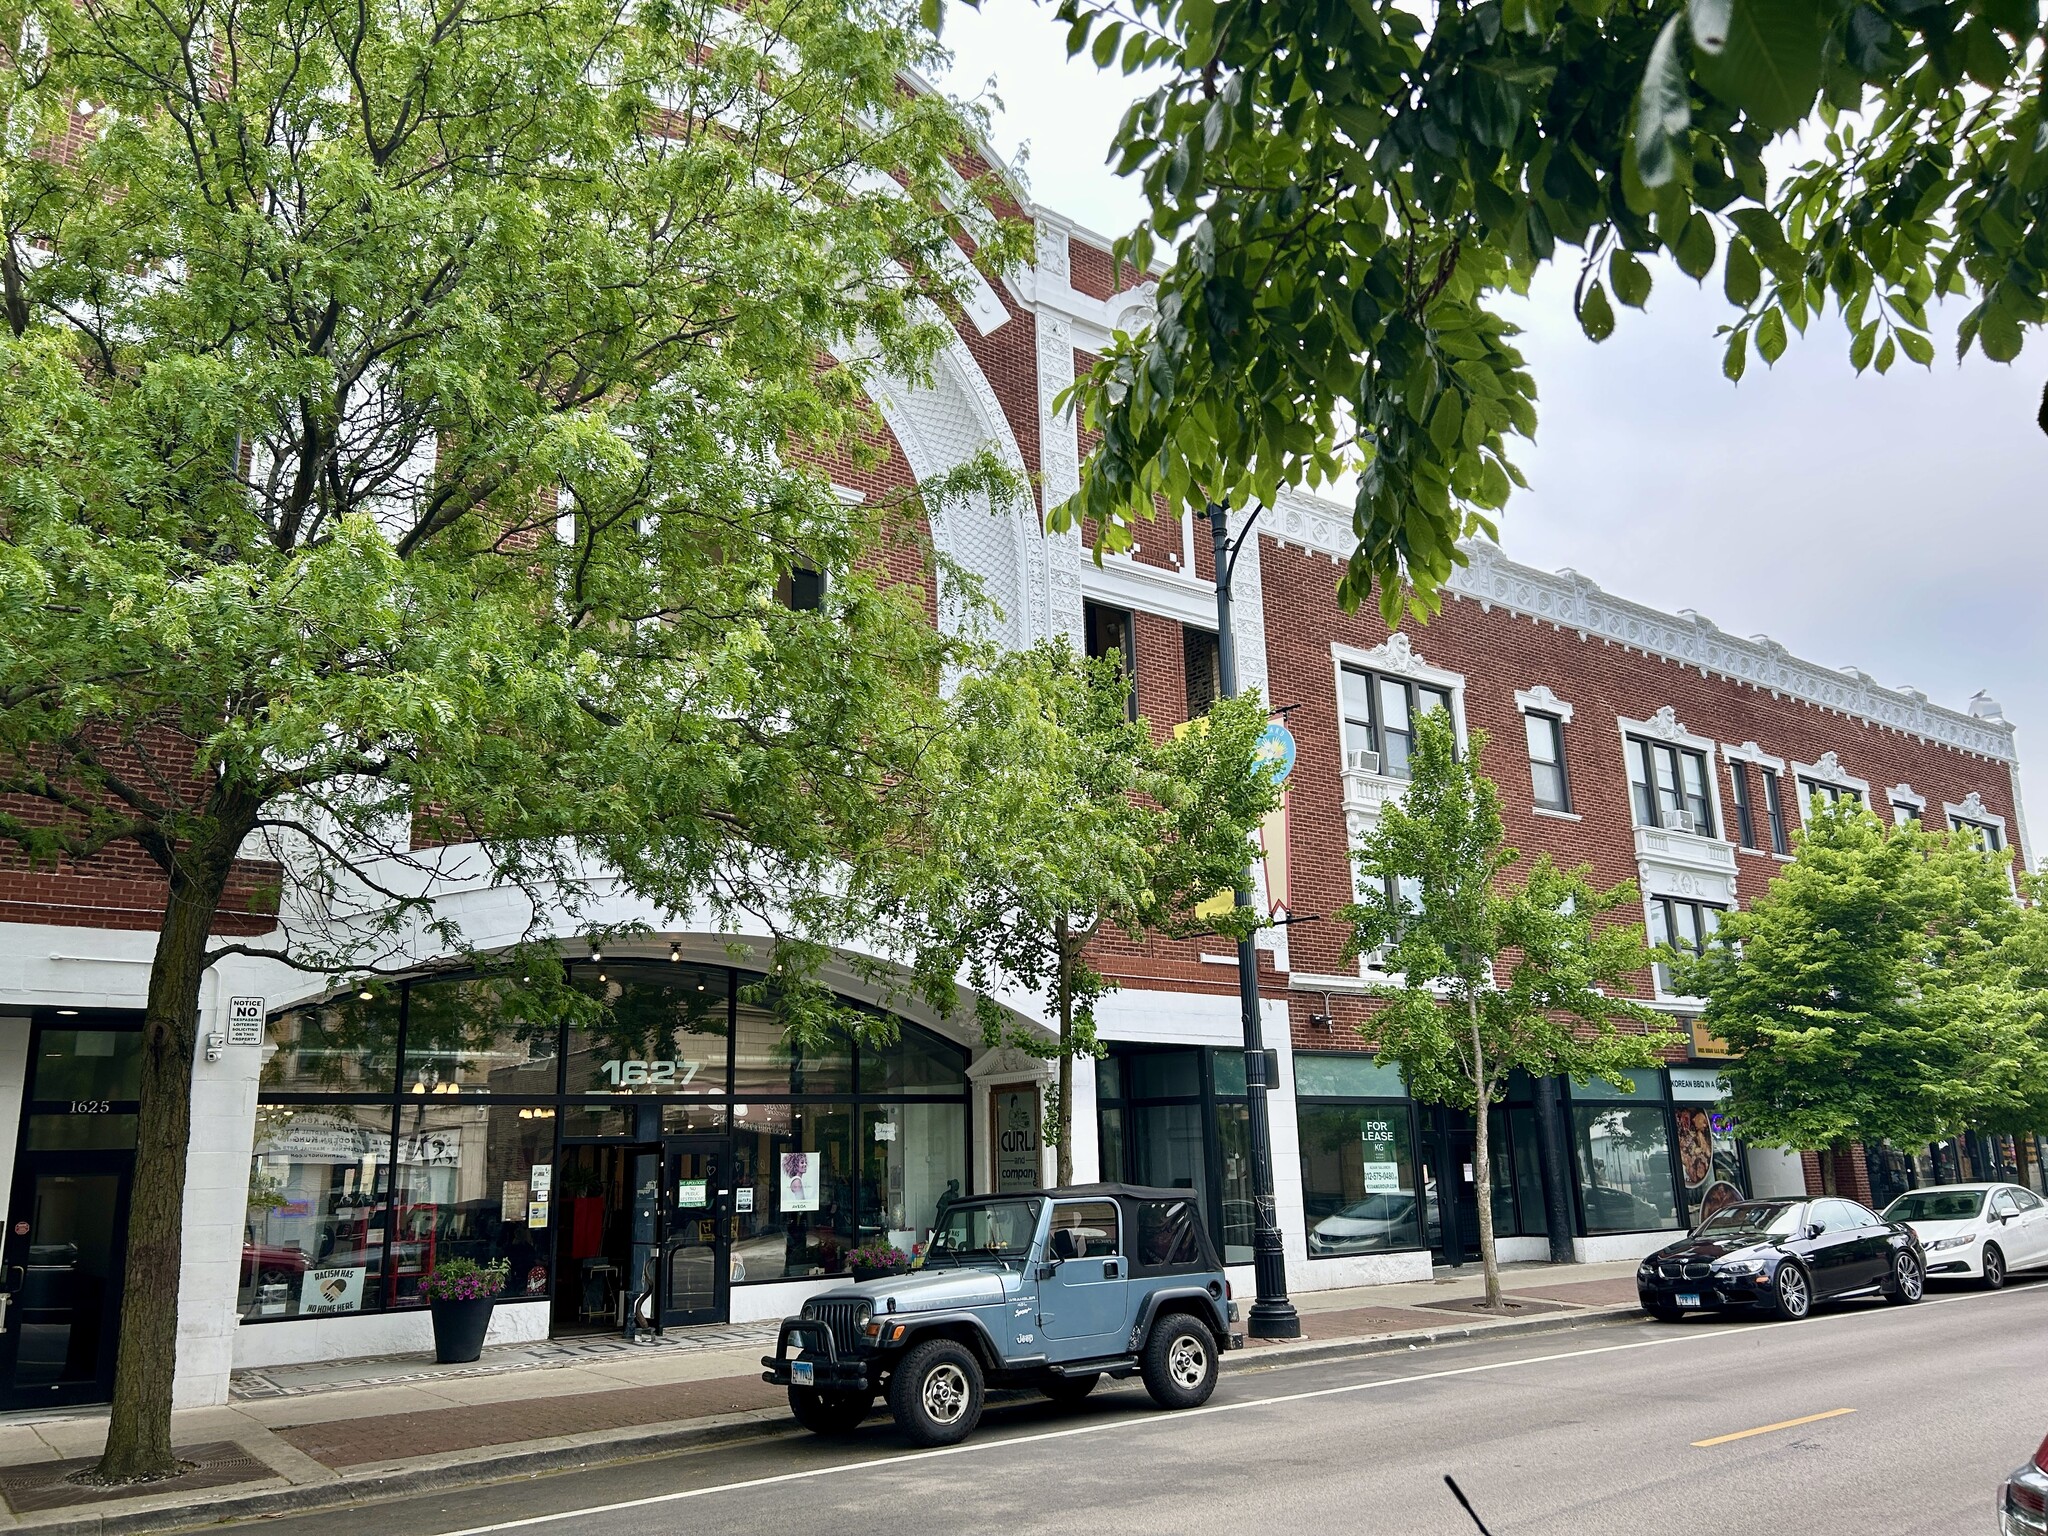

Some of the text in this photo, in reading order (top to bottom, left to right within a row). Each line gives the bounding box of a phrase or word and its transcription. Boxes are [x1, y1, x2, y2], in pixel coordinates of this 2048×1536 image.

[237, 1007, 258, 1017] NO
[600, 1059, 700, 1085] 1627
[1672, 1080, 1693, 1088] KOREAN
[1693, 1080, 1705, 1088] BBQ
[1705, 1080, 1711, 1088] IN
[1711, 1080, 1716, 1088] A
[69, 1100, 110, 1113] 1625
[1367, 1121, 1388, 1131] FOR
[1362, 1131, 1394, 1141] LEASE
[1374, 1143, 1384, 1151] KG
[1013, 1156, 1026, 1164] and
[1002, 1168, 1037, 1181] company
[314, 1269, 354, 1281] RACISM HAS
[306, 1301, 354, 1314] NO HOME HERE
[1016, 1333, 1034, 1344] Jeep
[525, 1330, 779, 1360] HOWAR
